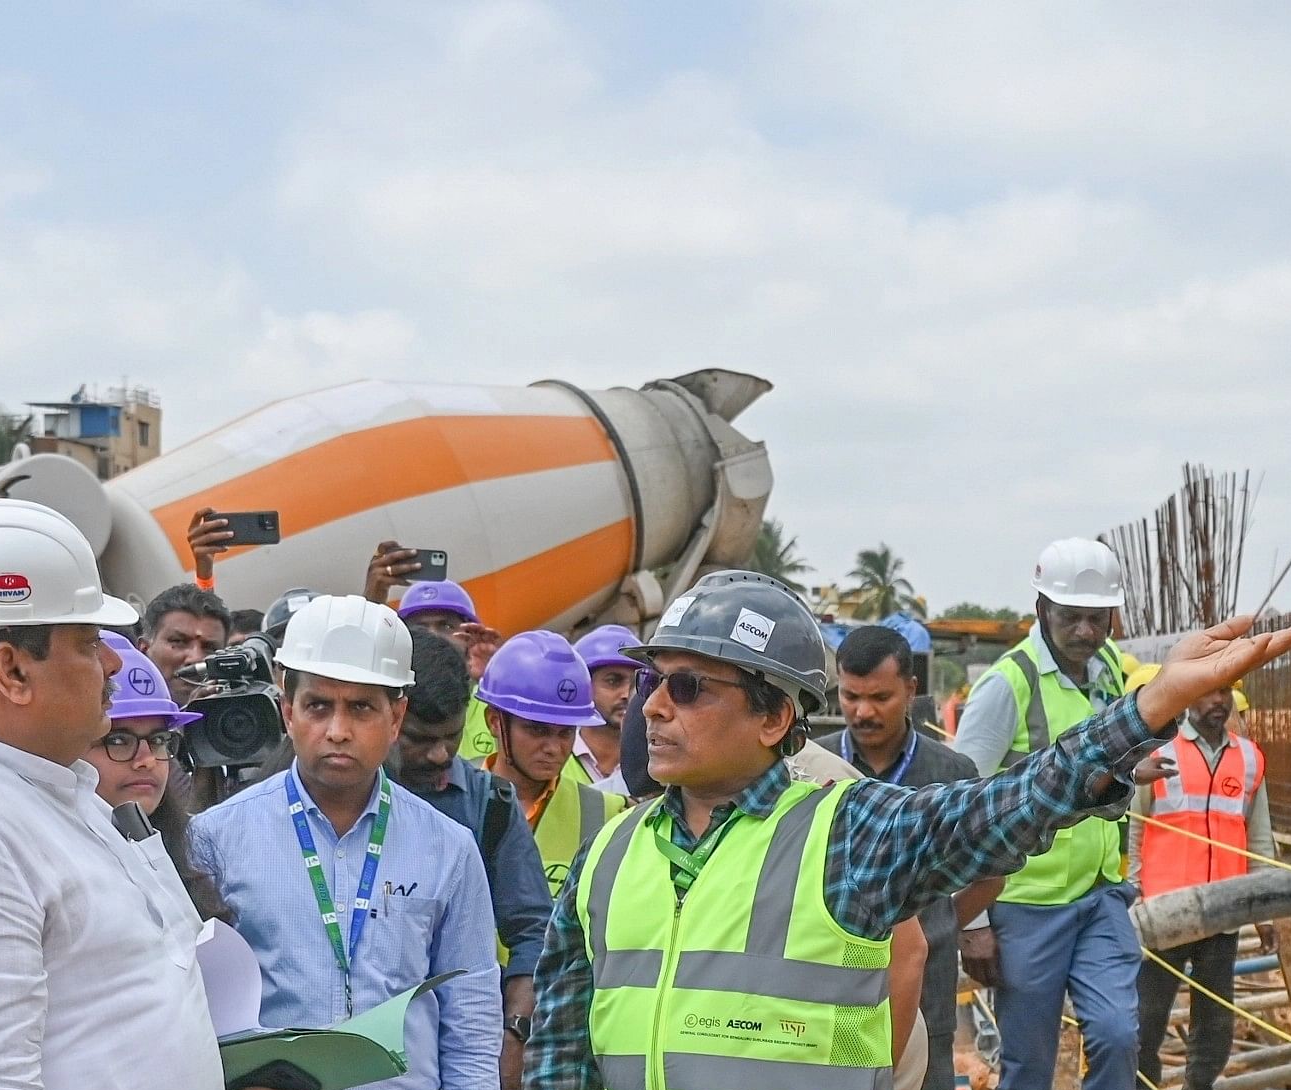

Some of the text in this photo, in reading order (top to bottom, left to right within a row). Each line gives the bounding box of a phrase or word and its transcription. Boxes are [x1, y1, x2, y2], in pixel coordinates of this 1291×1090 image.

[738, 622, 768, 640] AECOM
[699, 1016, 805, 1037] egis AECOM wsp
